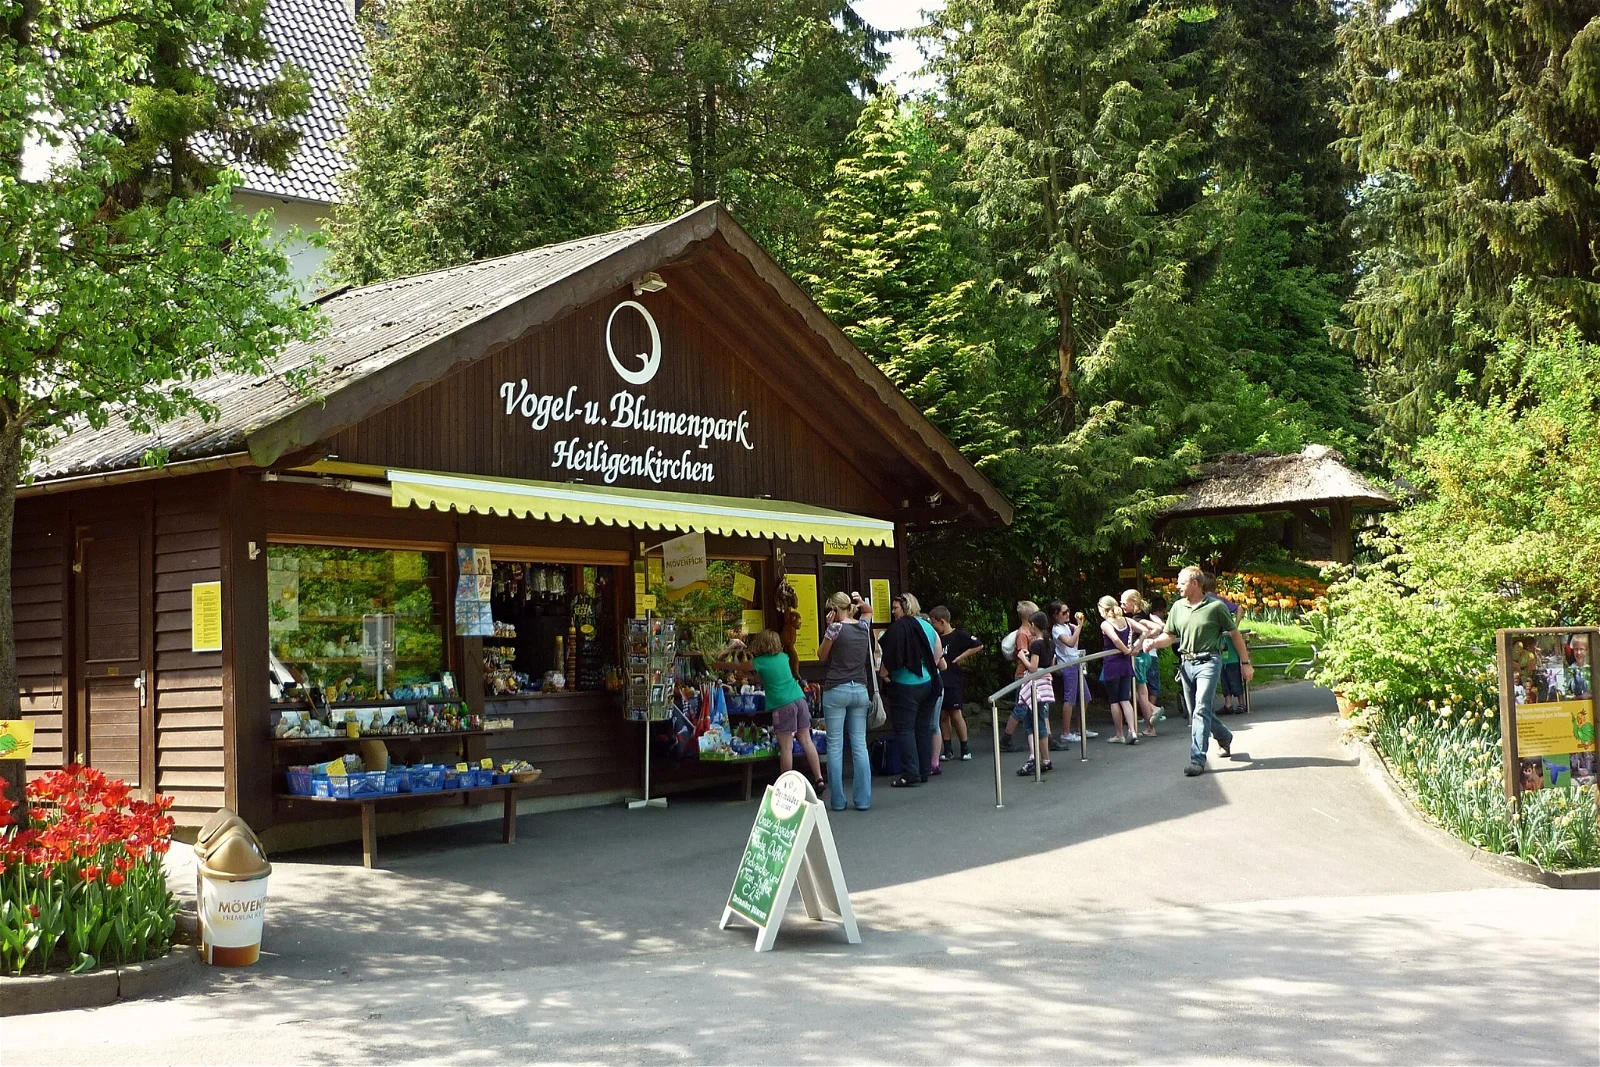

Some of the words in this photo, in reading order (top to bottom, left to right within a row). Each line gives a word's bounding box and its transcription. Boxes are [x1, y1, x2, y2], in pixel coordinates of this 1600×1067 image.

[610, 389, 754, 450] Blumenpark
[551, 437, 715, 484] Heiligenkirchen
[218, 899, 264, 913] MÖVEN
